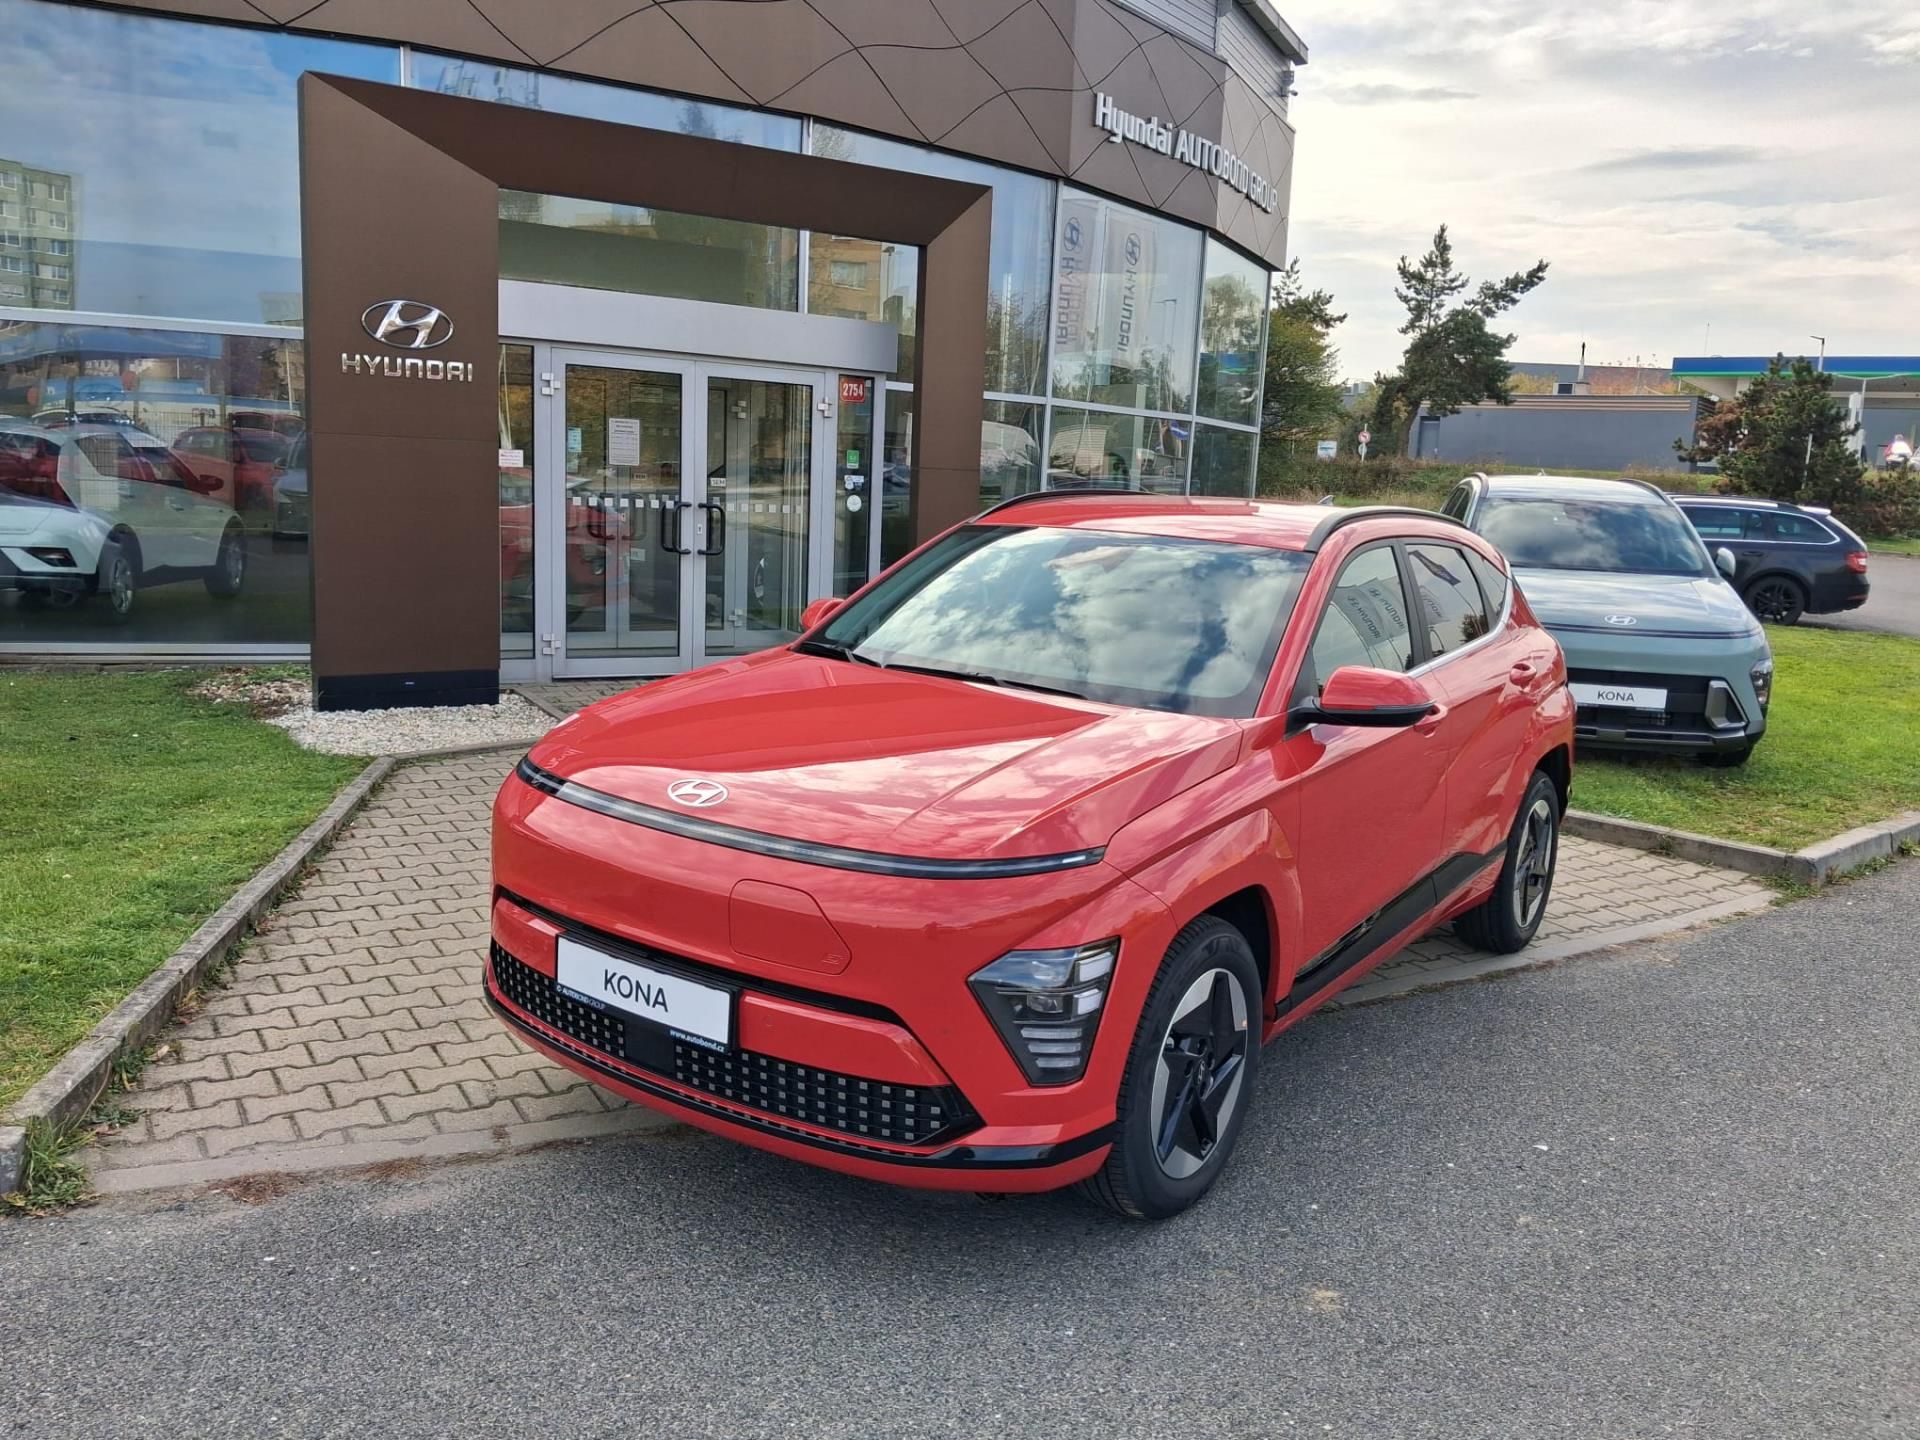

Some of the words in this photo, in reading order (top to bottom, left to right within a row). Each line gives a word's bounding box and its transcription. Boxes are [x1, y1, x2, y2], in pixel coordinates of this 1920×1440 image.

[1095, 92, 1173, 154] Hyundai
[1174, 129, 1249, 193] AUTOBOND
[1249, 171, 1278, 213] GROUP
[1056, 256, 1075, 345] HYUNDAI
[1117, 269, 1137, 353] HYUNDAI
[341, 353, 473, 382] HYUNDAI
[842, 383, 864, 397] 2754
[1597, 690, 1635, 702] KONA
[603, 968, 669, 1013] KONA
